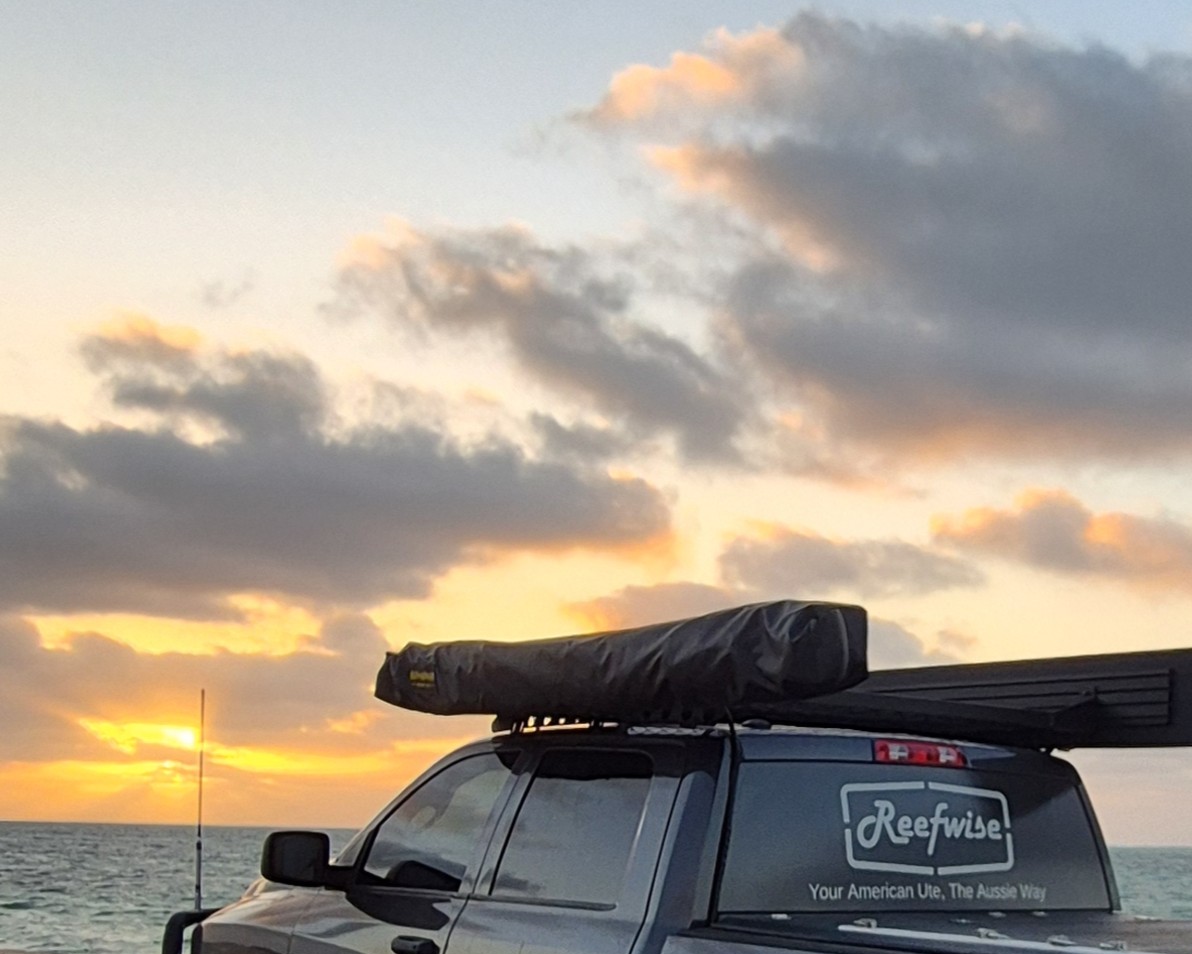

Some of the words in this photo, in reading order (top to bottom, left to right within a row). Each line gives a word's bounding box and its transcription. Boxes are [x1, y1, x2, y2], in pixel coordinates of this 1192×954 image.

[856, 800, 1002, 856] Reefwise
[808, 883, 844, 901] Your
[848, 881, 913, 901] American
[917, 882, 945, 901] Ute,
[949, 882, 974, 901] The
[976, 883, 1018, 901] Aussie
[1020, 884, 1046, 902] Way
